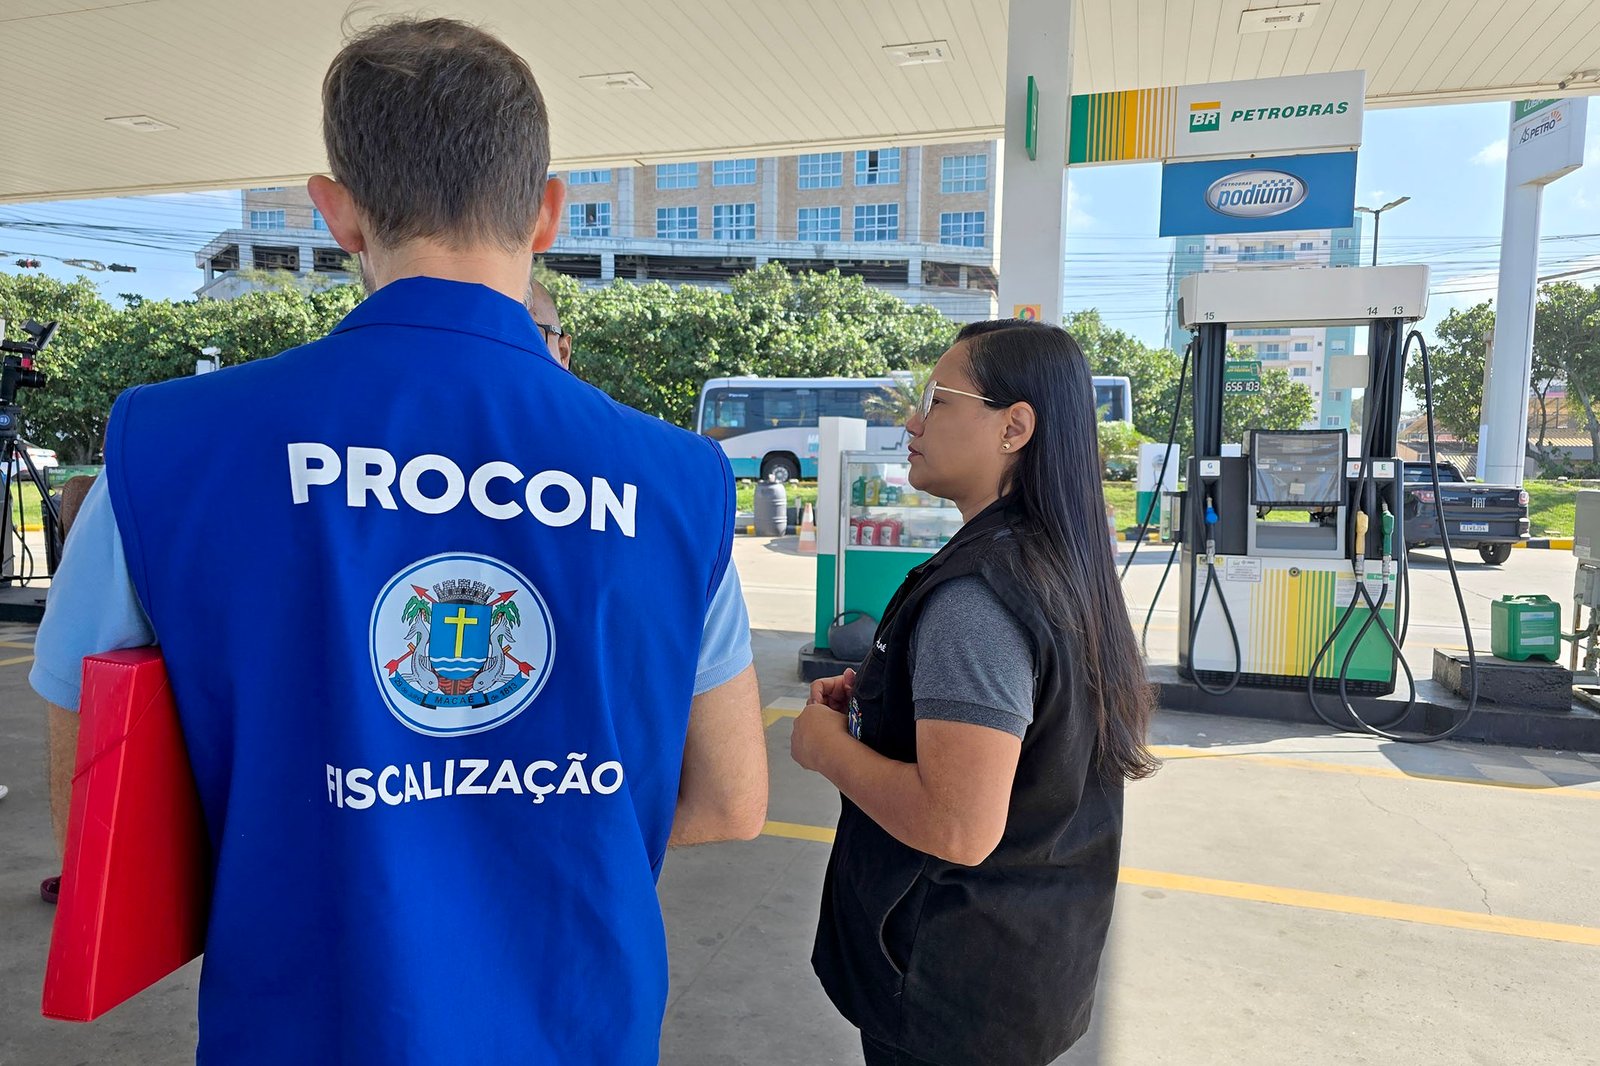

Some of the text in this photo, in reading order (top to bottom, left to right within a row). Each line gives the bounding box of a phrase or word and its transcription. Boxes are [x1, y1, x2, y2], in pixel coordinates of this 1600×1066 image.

[1191, 101, 1349, 126] BR PETROBRAS
[1216, 184, 1294, 209] podium
[1204, 311, 1215, 320] 15
[1367, 306, 1378, 316] 14
[1392, 306, 1404, 315] 13
[287, 442, 638, 538] PROCON
[1471, 497, 1486, 508] FIAT
[500, 683, 518, 696] 1813
[435, 694, 474, 704] MACAÉ
[326, 752, 624, 810] FISCALIZAÇÃO
